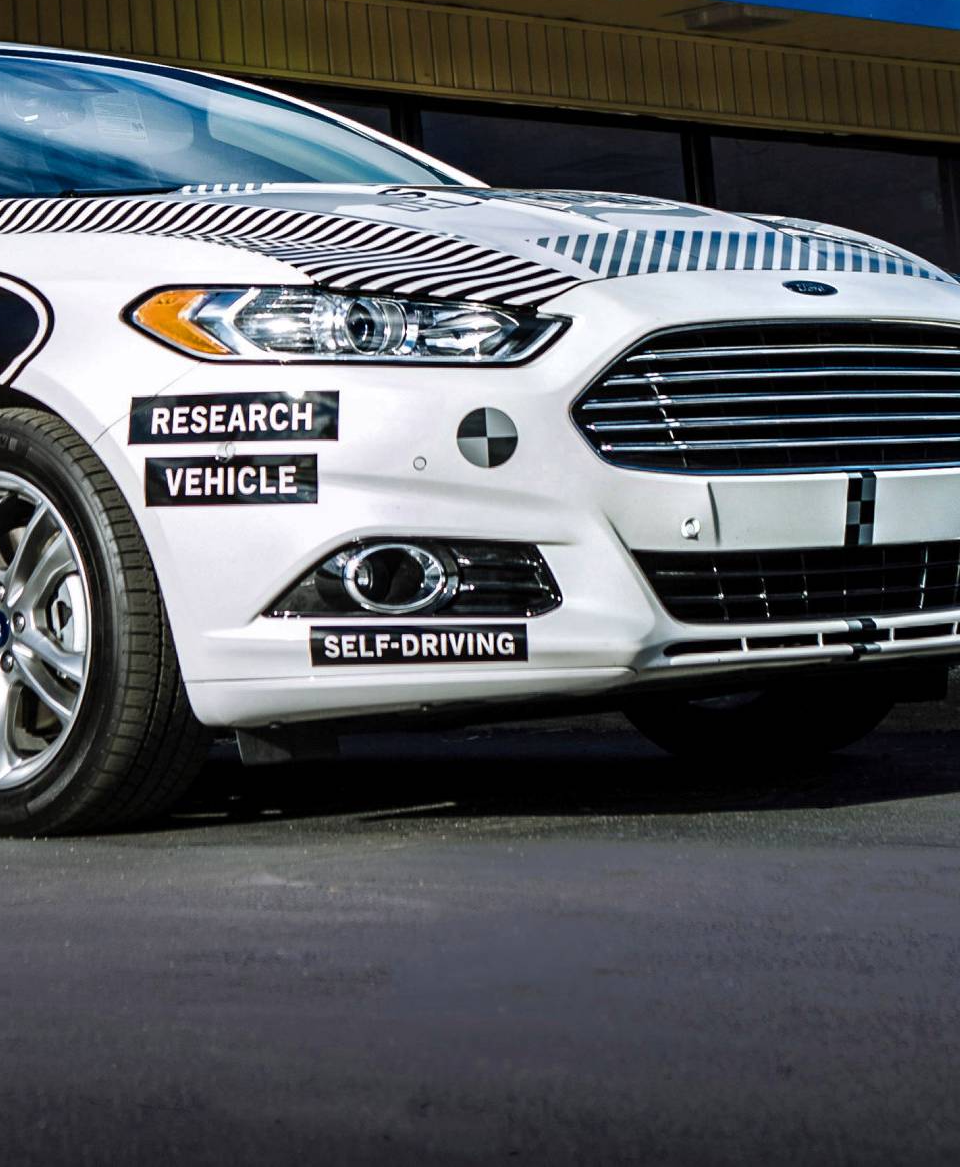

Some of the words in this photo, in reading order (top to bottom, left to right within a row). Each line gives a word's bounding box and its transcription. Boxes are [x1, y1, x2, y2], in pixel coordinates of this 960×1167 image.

[151, 402, 313, 435] RESEARCH
[164, 465, 298, 497] VEHICLE
[323, 631, 516, 659] SELF-DRIVING
